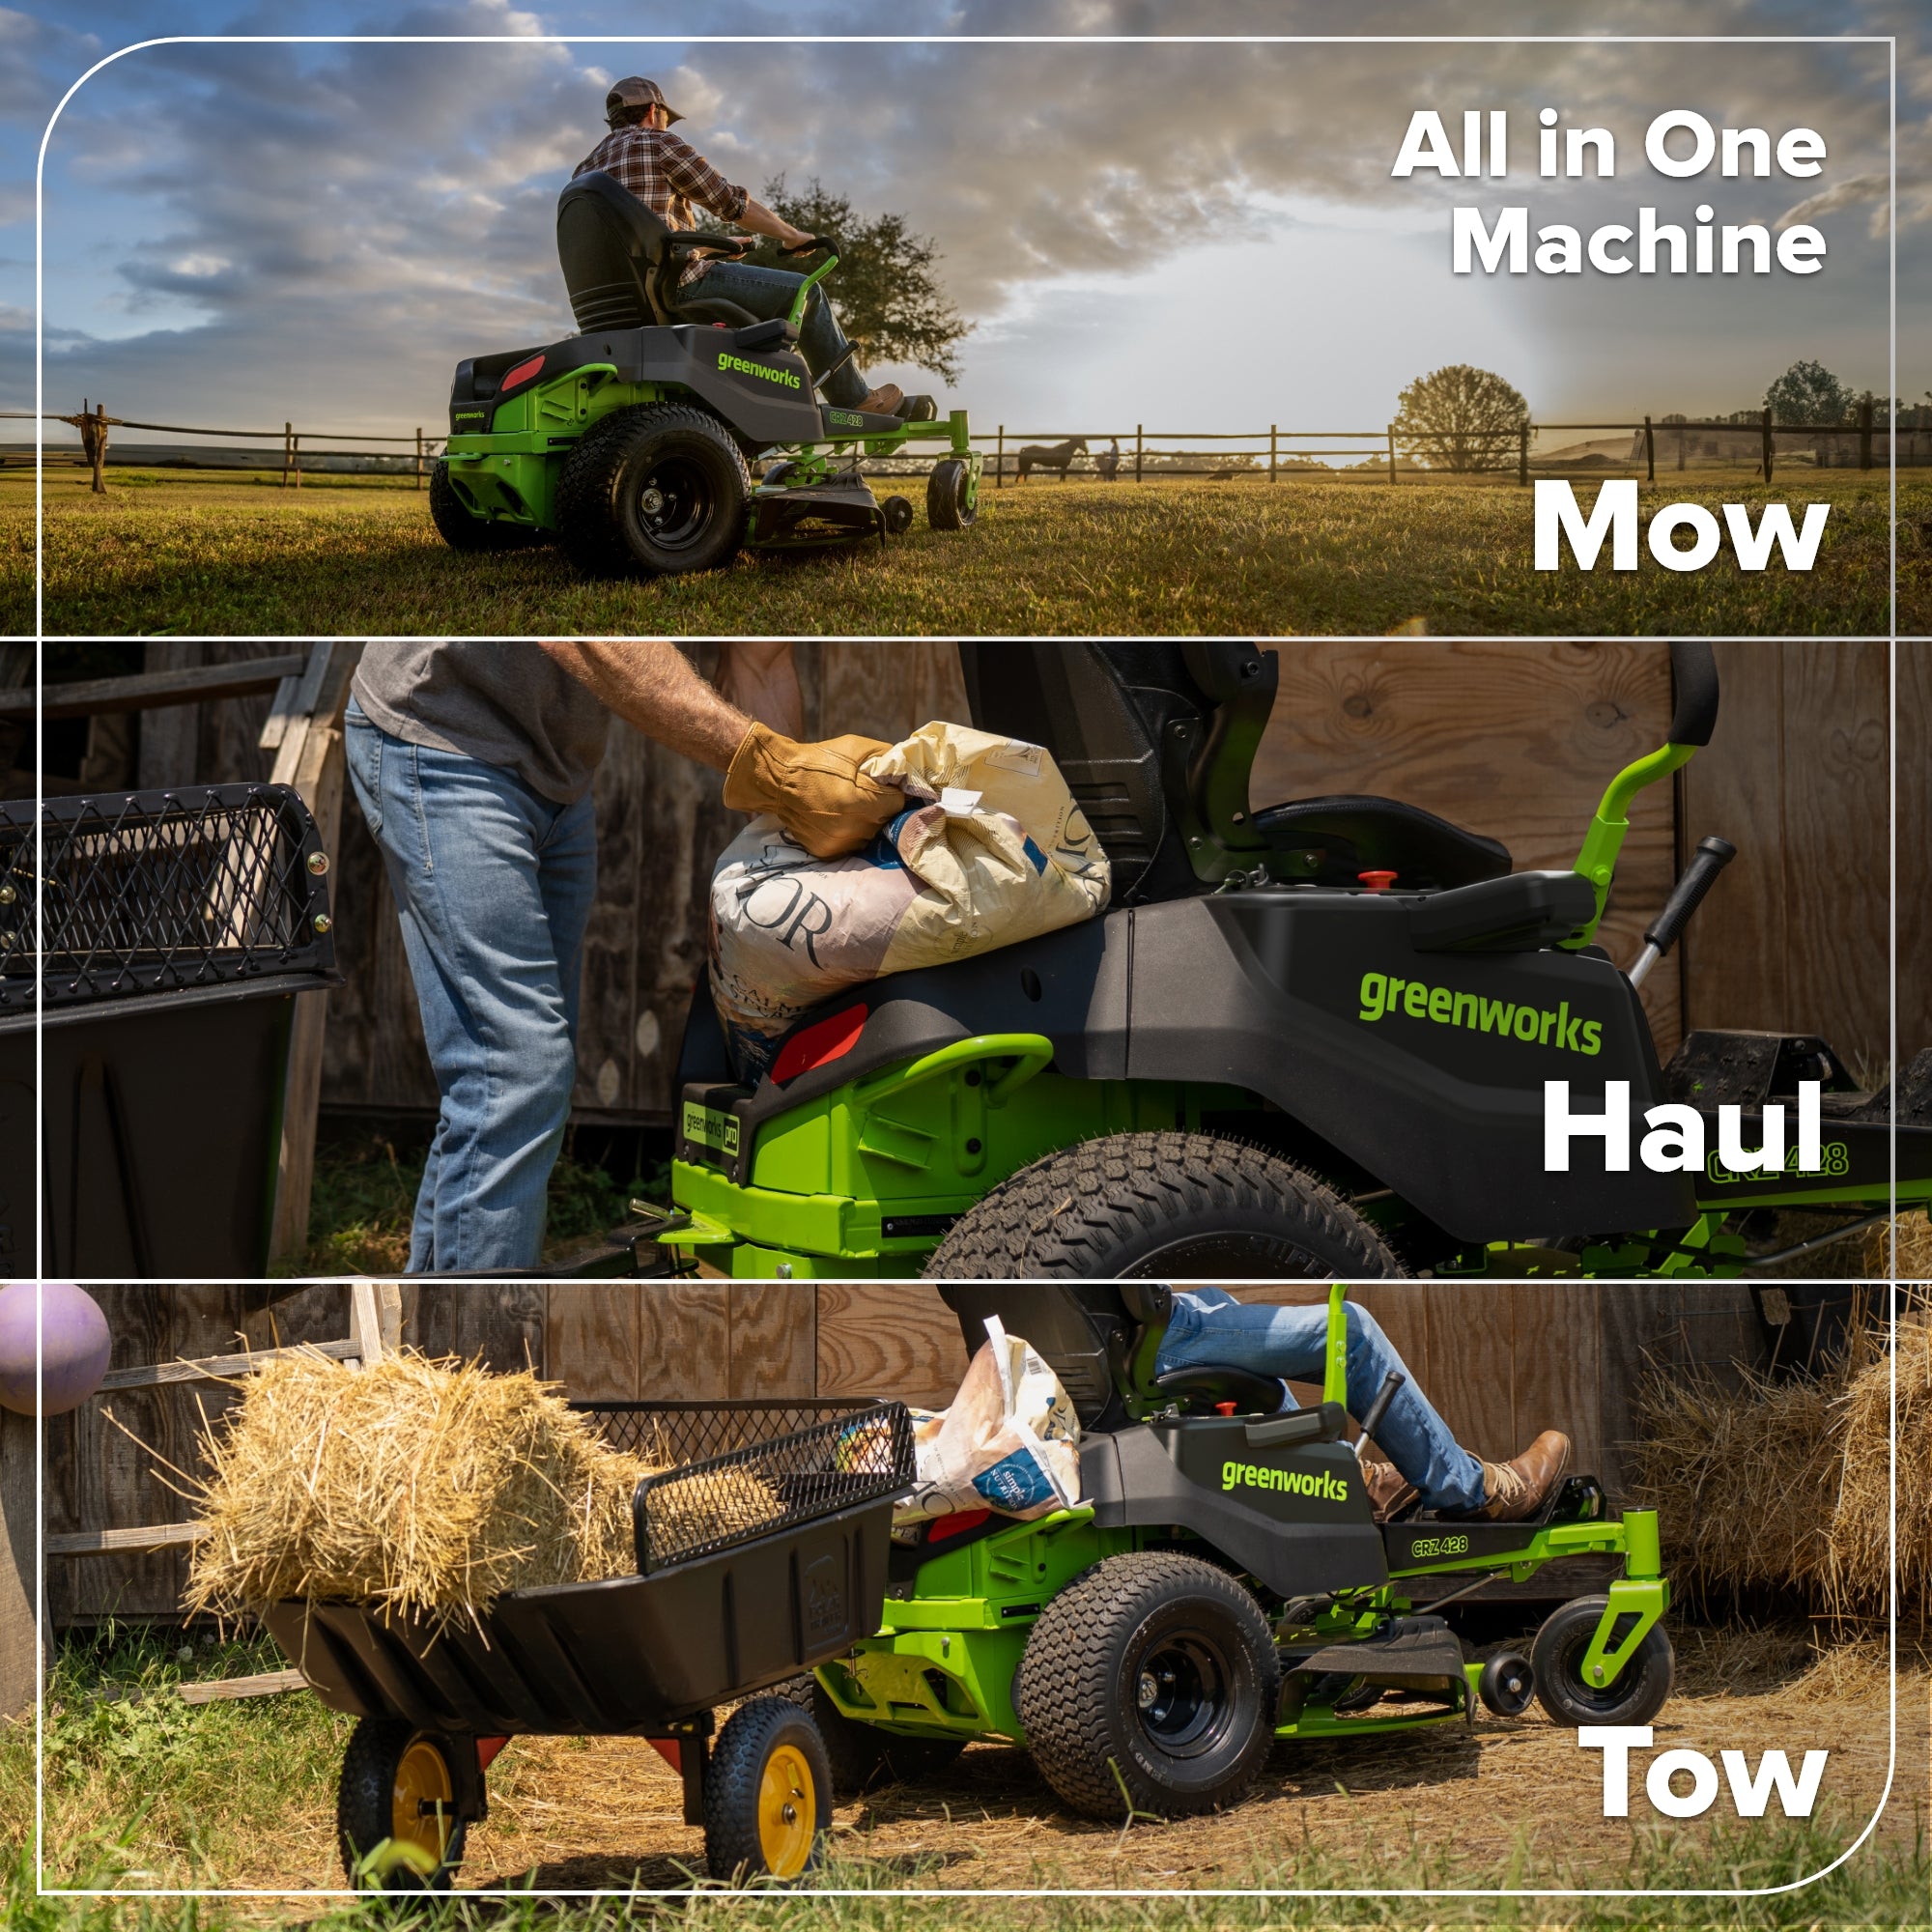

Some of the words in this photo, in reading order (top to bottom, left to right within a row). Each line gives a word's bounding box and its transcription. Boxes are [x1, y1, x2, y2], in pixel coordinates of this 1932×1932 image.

[717, 350, 802, 390] greenworks
[847, 413, 863, 427] 428
[1359, 972, 1603, 1057] greenworks
[687, 1113, 723, 1138] greenworks
[724, 1125, 737, 1147] pro
[1003, 1470, 1026, 1501] simple
[1221, 1461, 1349, 1502] greenworks
[1411, 1539, 1439, 1558] CRZ
[1440, 1535, 1468, 1554] 428
